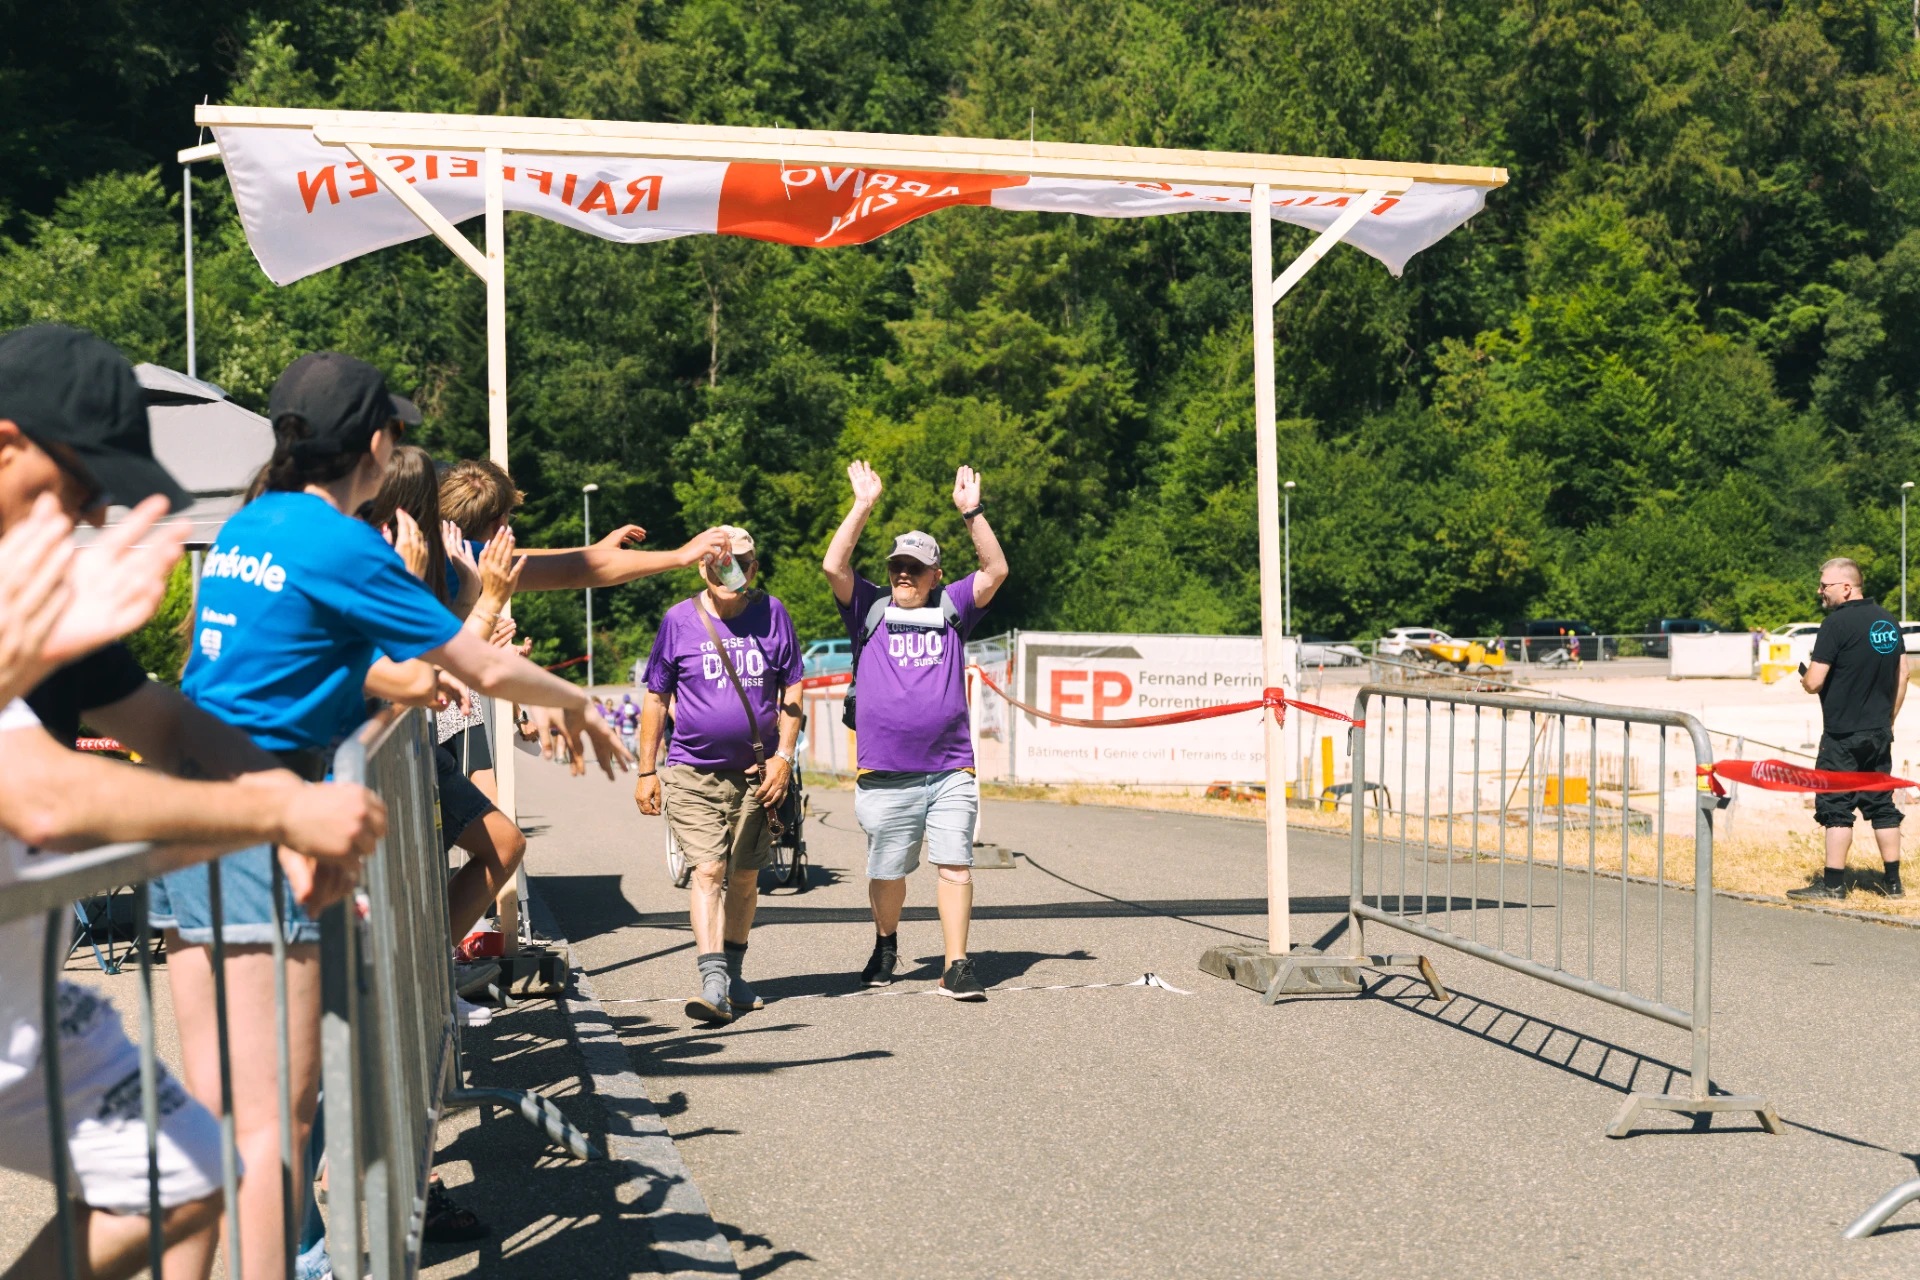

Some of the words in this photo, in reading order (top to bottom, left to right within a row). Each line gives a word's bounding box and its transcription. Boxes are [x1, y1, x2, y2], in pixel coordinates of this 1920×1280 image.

[202, 544, 286, 592] énévole
[700, 637, 745, 652] CORSE
[889, 631, 942, 658] DUO
[703, 649, 764, 680] DUO
[738, 677, 764, 688] UISSE
[1138, 671, 1207, 686] Fernand
[1214, 672, 1263, 687] Perrin
[1050, 670, 1133, 727] FP
[1027, 746, 1089, 758] Bâtiments
[1142, 747, 1166, 759] civil
[1180, 748, 1227, 761] Terrains
[1231, 749, 1246, 761] de
[1752, 761, 1829, 789] RAIFFEISEN
